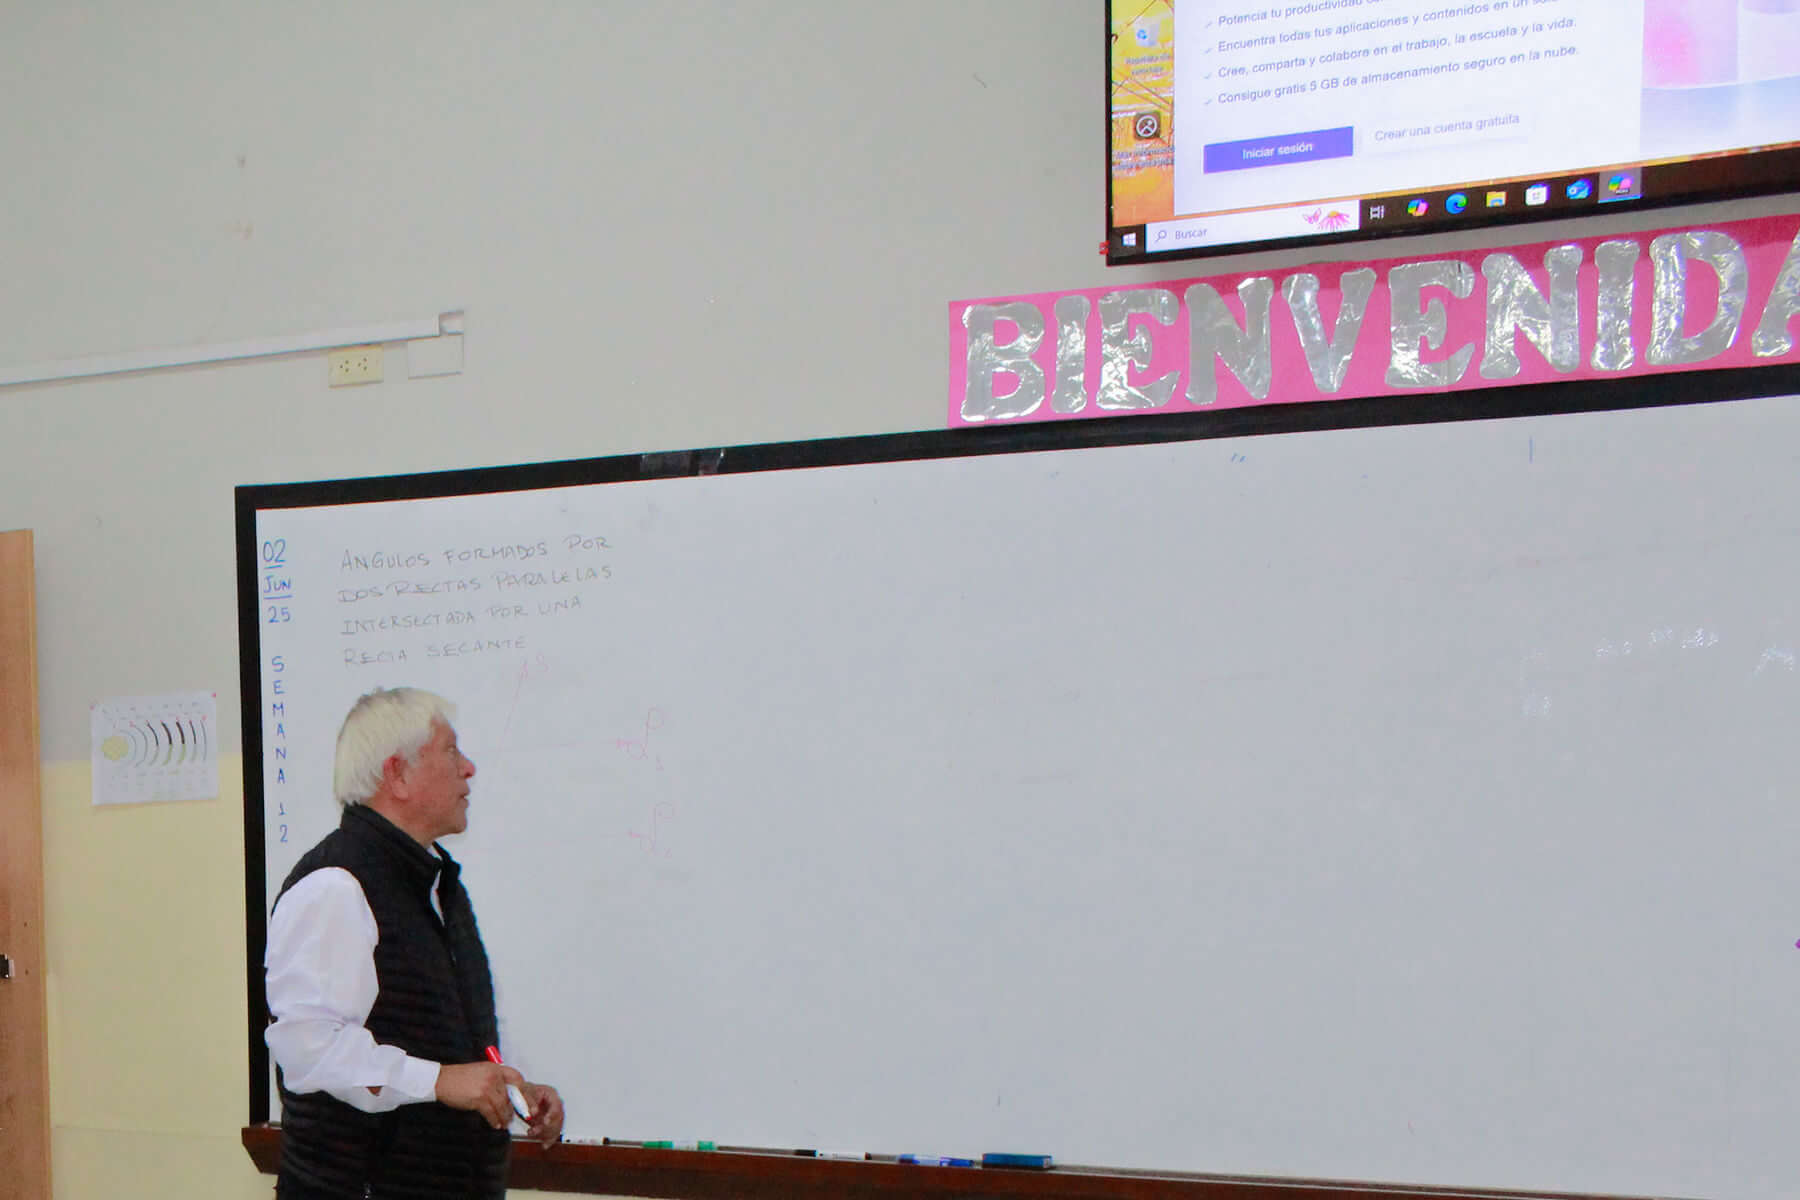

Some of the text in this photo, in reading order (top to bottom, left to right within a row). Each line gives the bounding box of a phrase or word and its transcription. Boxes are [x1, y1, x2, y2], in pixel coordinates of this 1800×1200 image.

[1218, 11, 1267, 26] Potencia
[1271, 9, 1281, 18] tu
[1218, 36, 1276, 52] Encuentra
[1279, 31, 1311, 43] todas
[1314, 27, 1332, 38] tus
[1335, 15, 1409, 35] aplicaciones
[1412, 15, 1419, 25] y
[1422, 4, 1490, 22] contenidos
[1493, 2, 1509, 11] en
[1218, 16, 1577, 79] Cree, comparta y colabore en el trabajo, la escuela y la vida.
[1218, 45, 1579, 105] Consigue gratis 5 GB de almacenamiento seguro en la nube.
[1375, 113, 1520, 142] Crear una cuenta gratuita
[1242, 141, 1313, 160] Iniciar sesión
[1175, 228, 1208, 240] Buscar
[262, 539, 287, 563] 02
[341, 533, 613, 569] ANGULOS FORMADOS POR
[337, 584, 384, 603] DOS
[385, 576, 481, 596] RECTAS
[267, 606, 291, 623] 25
[487, 603, 528, 618] POR
[538, 594, 582, 616] UNA
